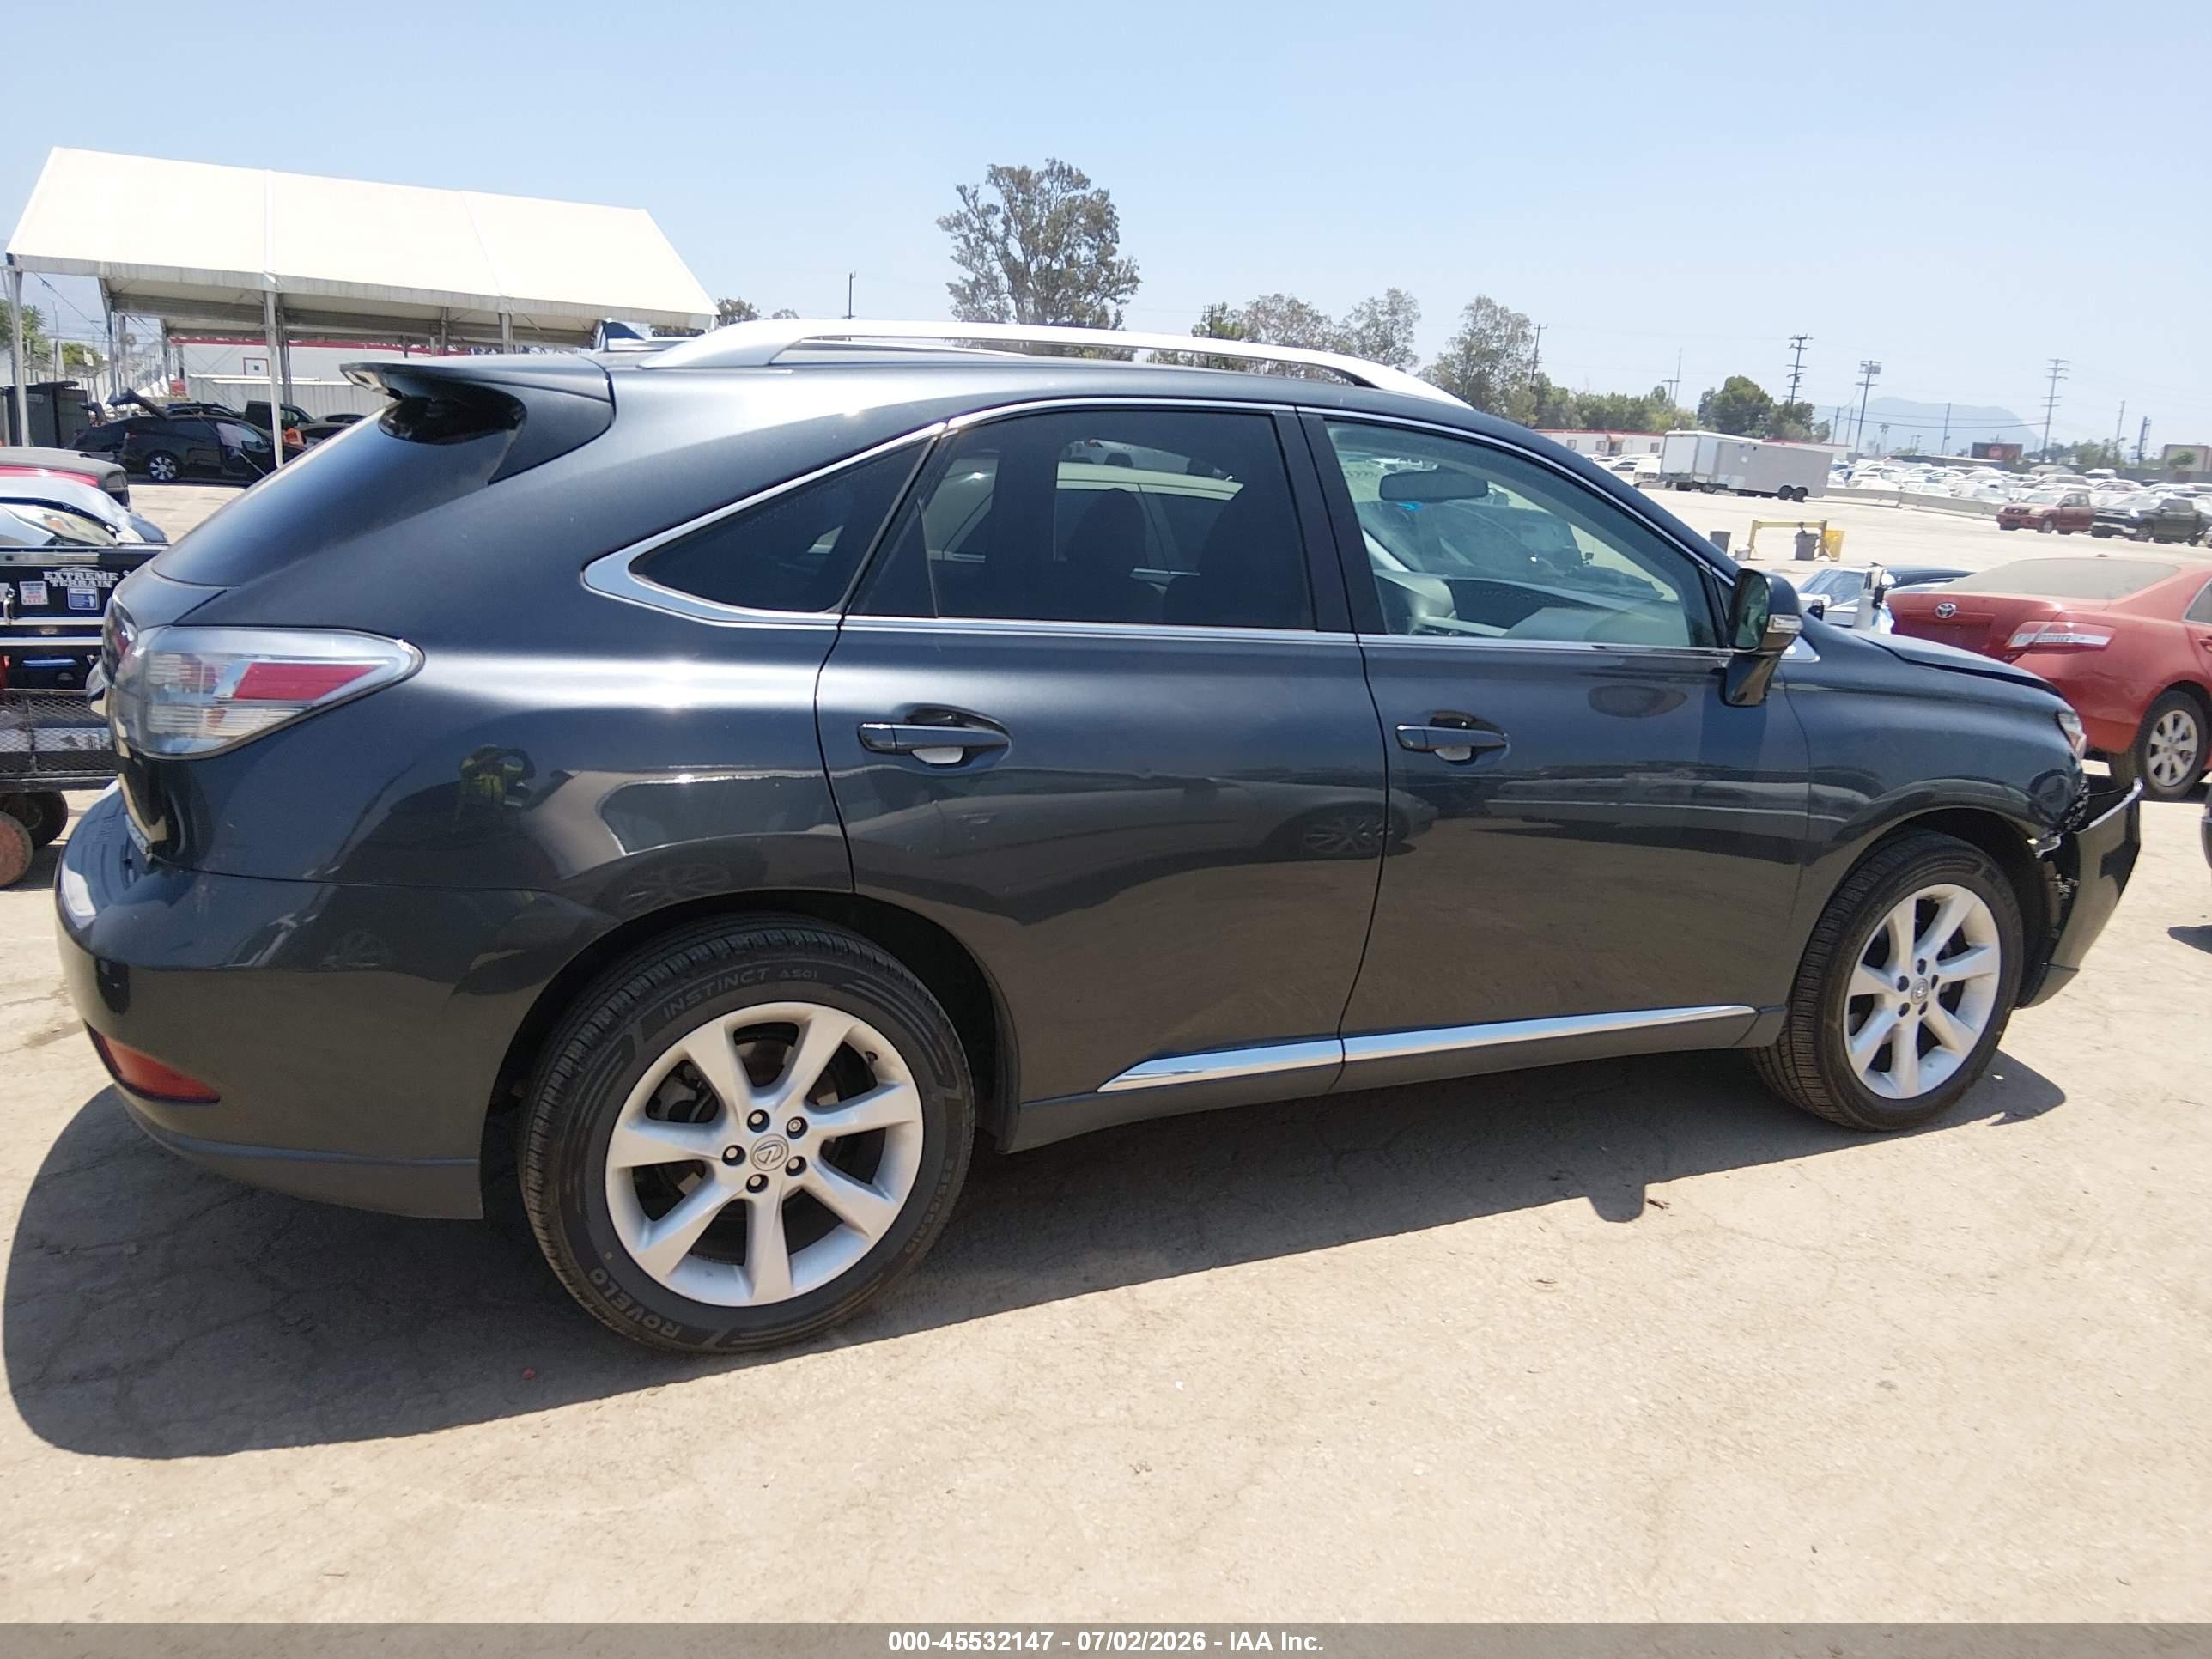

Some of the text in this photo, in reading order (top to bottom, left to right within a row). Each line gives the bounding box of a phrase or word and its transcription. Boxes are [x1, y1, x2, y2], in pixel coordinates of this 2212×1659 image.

[43, 571, 118, 580] EXTREME
[49, 580, 112, 588] TERRAIN
[662, 967, 770, 1020] INSTINCT
[588, 1267, 682, 1340] ROVELO
